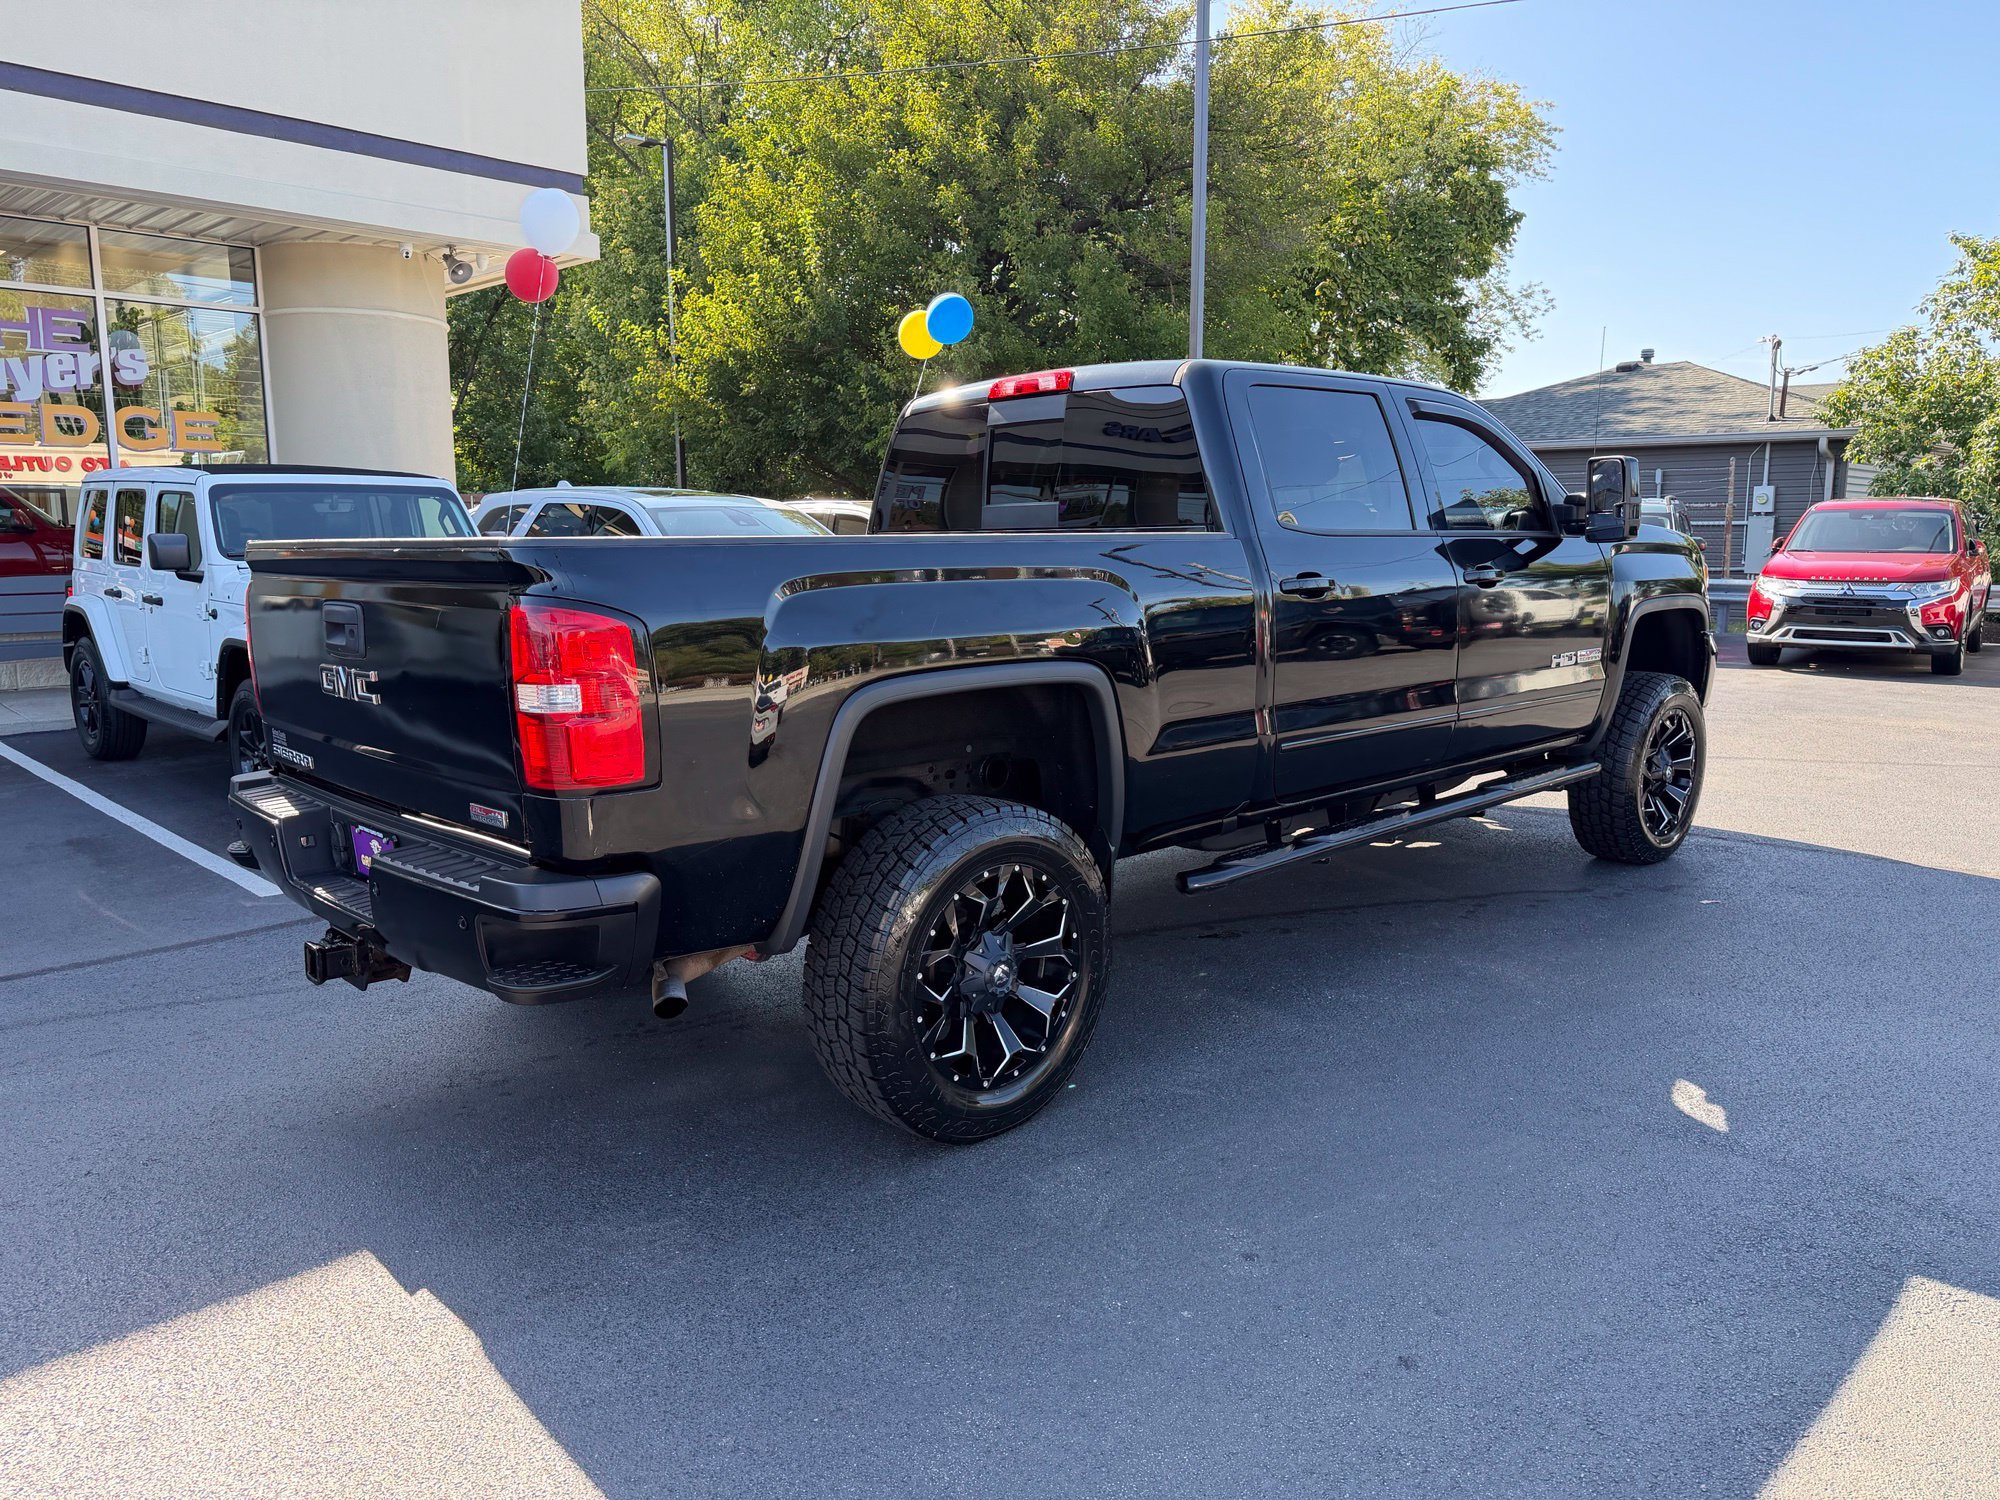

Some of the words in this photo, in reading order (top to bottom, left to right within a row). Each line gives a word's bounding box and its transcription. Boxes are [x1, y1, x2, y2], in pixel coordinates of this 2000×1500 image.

[0, 401, 223, 452] EDGE
[1551, 651, 1577, 668] HD
[319, 663, 381, 705] GMC
[272, 743, 315, 770] SIERRA
